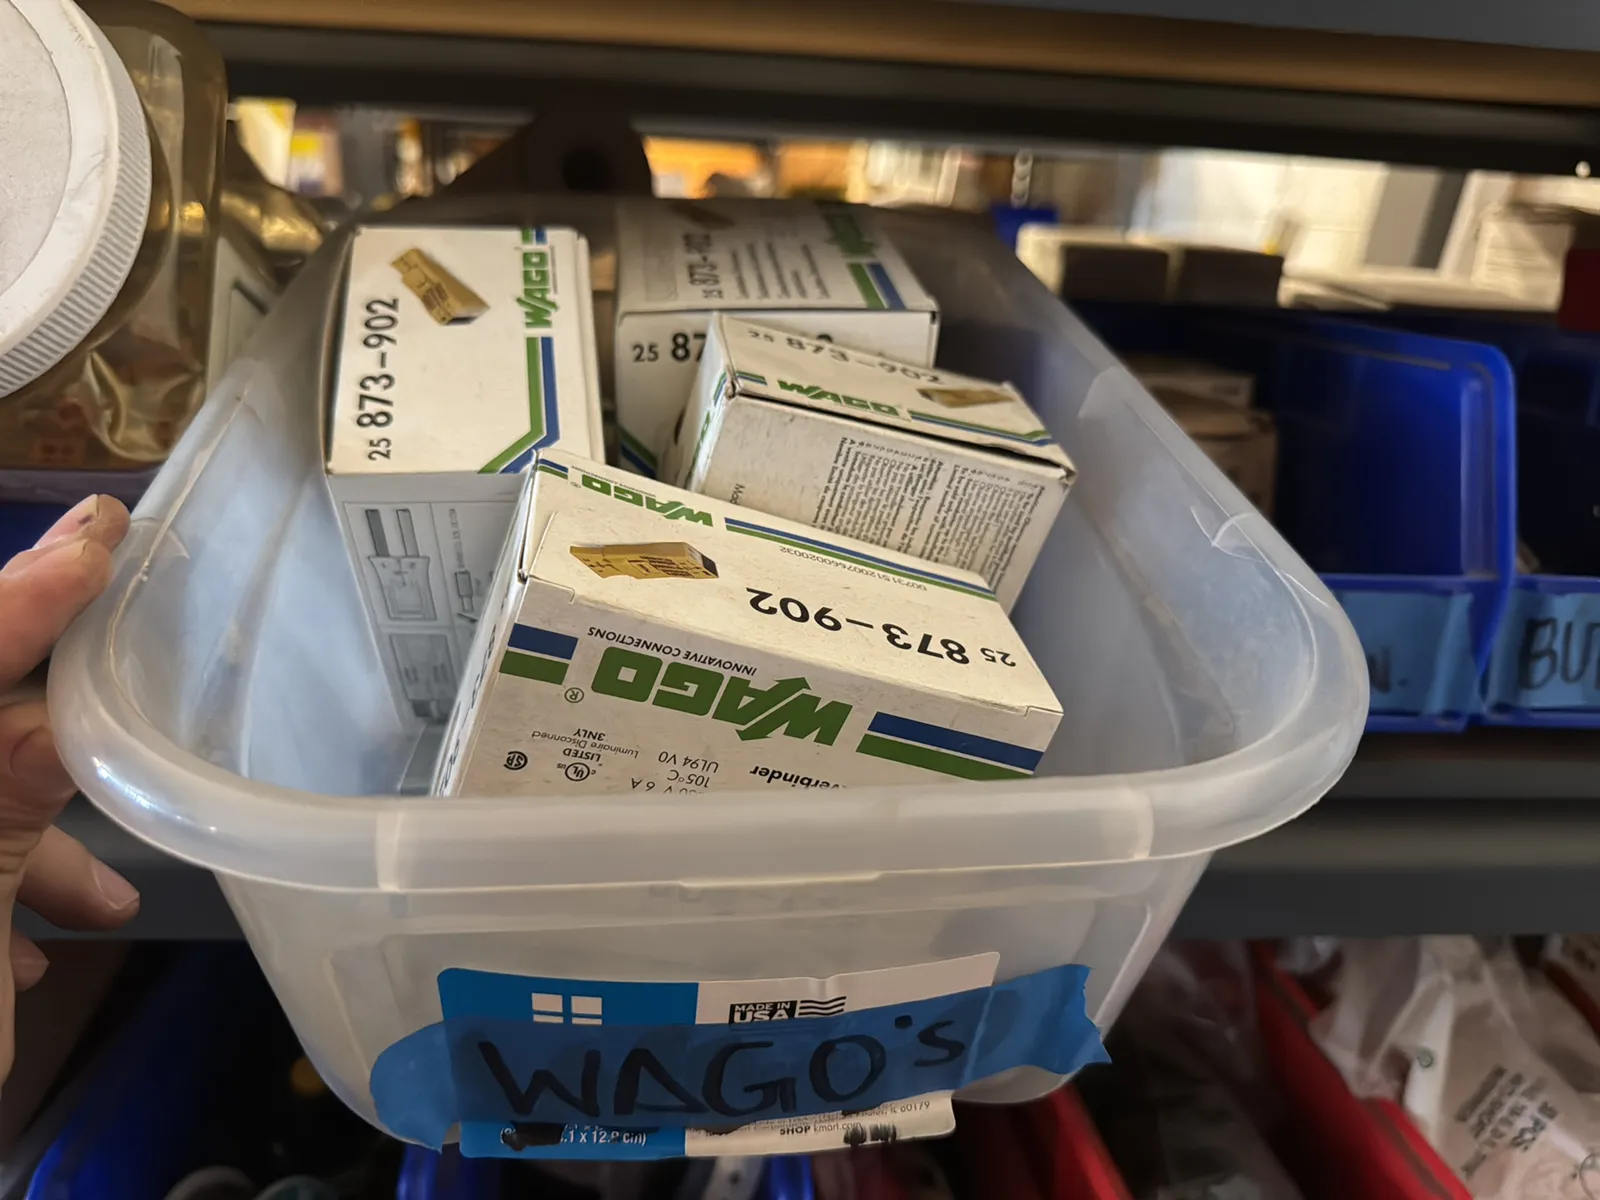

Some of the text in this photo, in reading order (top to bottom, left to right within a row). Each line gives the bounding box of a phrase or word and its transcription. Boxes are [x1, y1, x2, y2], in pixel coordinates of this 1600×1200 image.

[515, 251, 560, 328] WAGO
[632, 332, 709, 363] 25 87
[356, 297, 399, 461] 25 873-902
[777, 379, 901, 417] WAGO
[581, 473, 714, 528] WAGO
[745, 586, 1017, 668] 25 873-902
[587, 626, 758, 677] INNOVATIVE CONNECTIONS
[1518, 616, 1600, 692] BU
[591, 646, 853, 747] WAGO
[573, 728, 606, 742] 3NLY
[563, 747, 602, 762] LISTED
[590, 741, 640, 760] Luminaire
[682, 755, 719, 774] UL94
[629, 777, 644, 790] A
[646, 781, 656, 792] 6
[749, 765, 845, 789] verbinder
[733, 1009, 789, 1023] USA
[734, 1001, 791, 1013] MADE IN
[779, 1125, 811, 1136] SHOP
